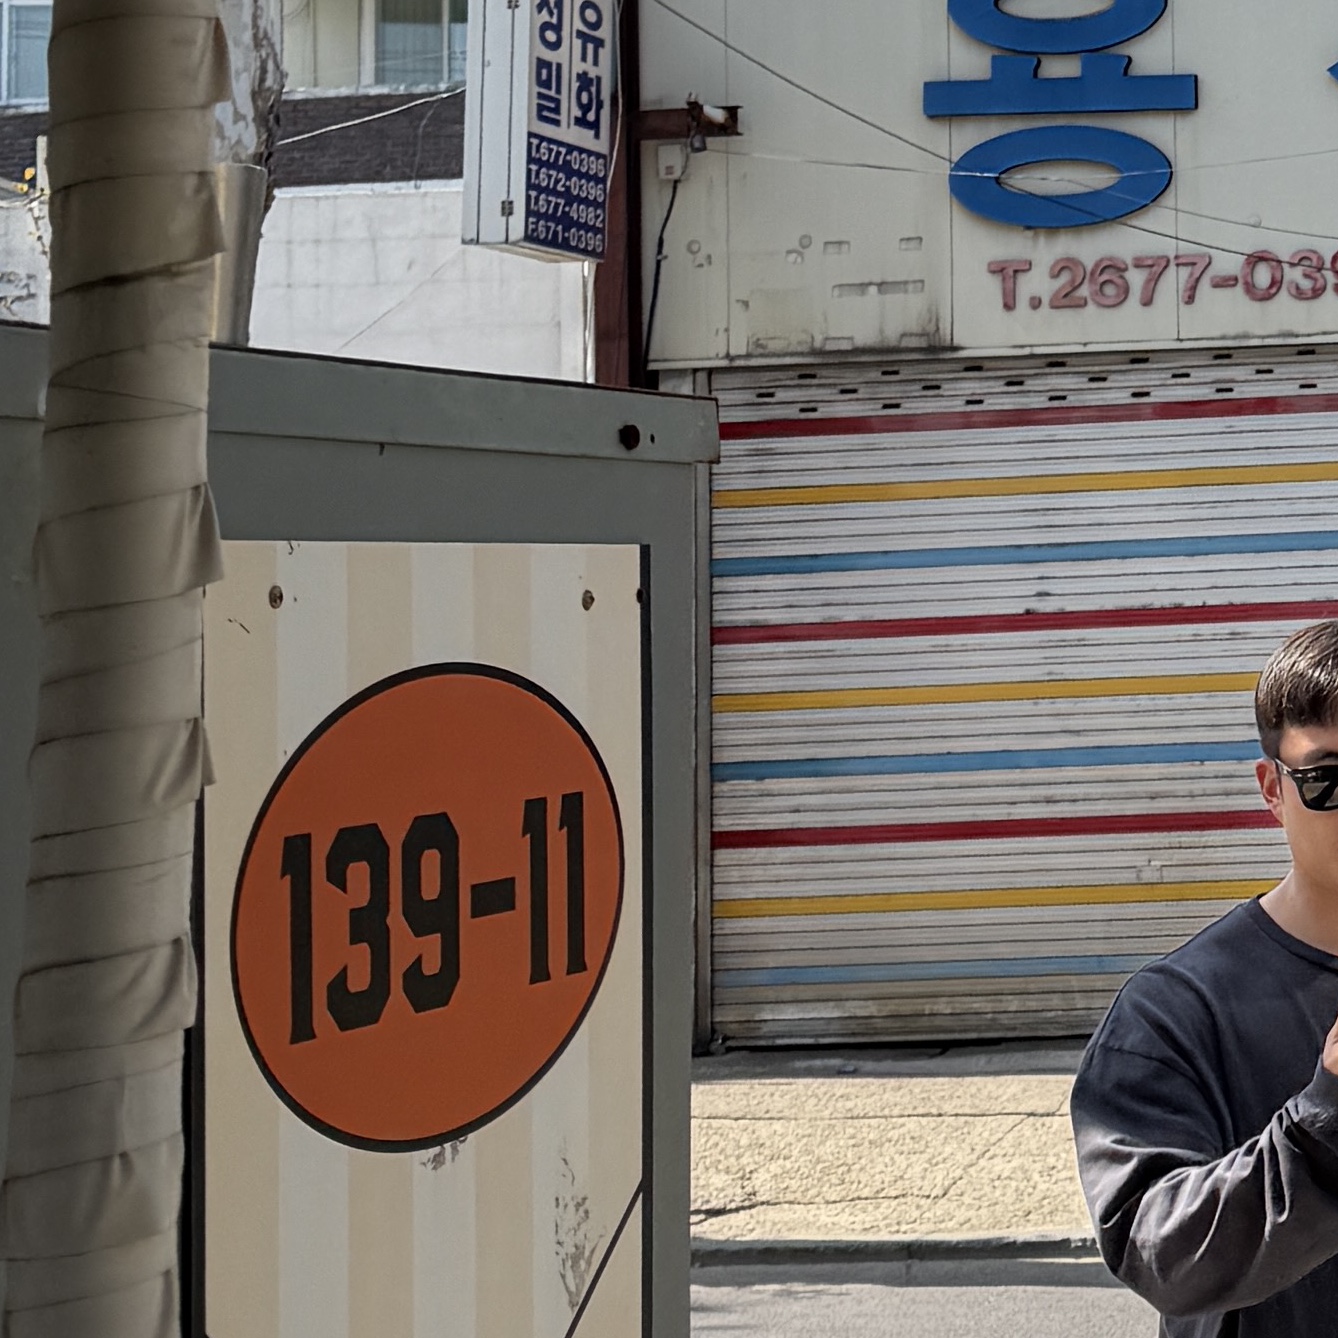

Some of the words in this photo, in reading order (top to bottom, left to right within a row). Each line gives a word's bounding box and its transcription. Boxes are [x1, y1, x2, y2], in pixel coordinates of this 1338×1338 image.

[529, 138, 606, 178] T.677-0396
[528, 164, 605, 203] T.672-0396
[528, 190, 604, 228] T.677-4982
[527, 217, 603, 253] F.671-0396
[280, 791, 588, 1046] 139-11
